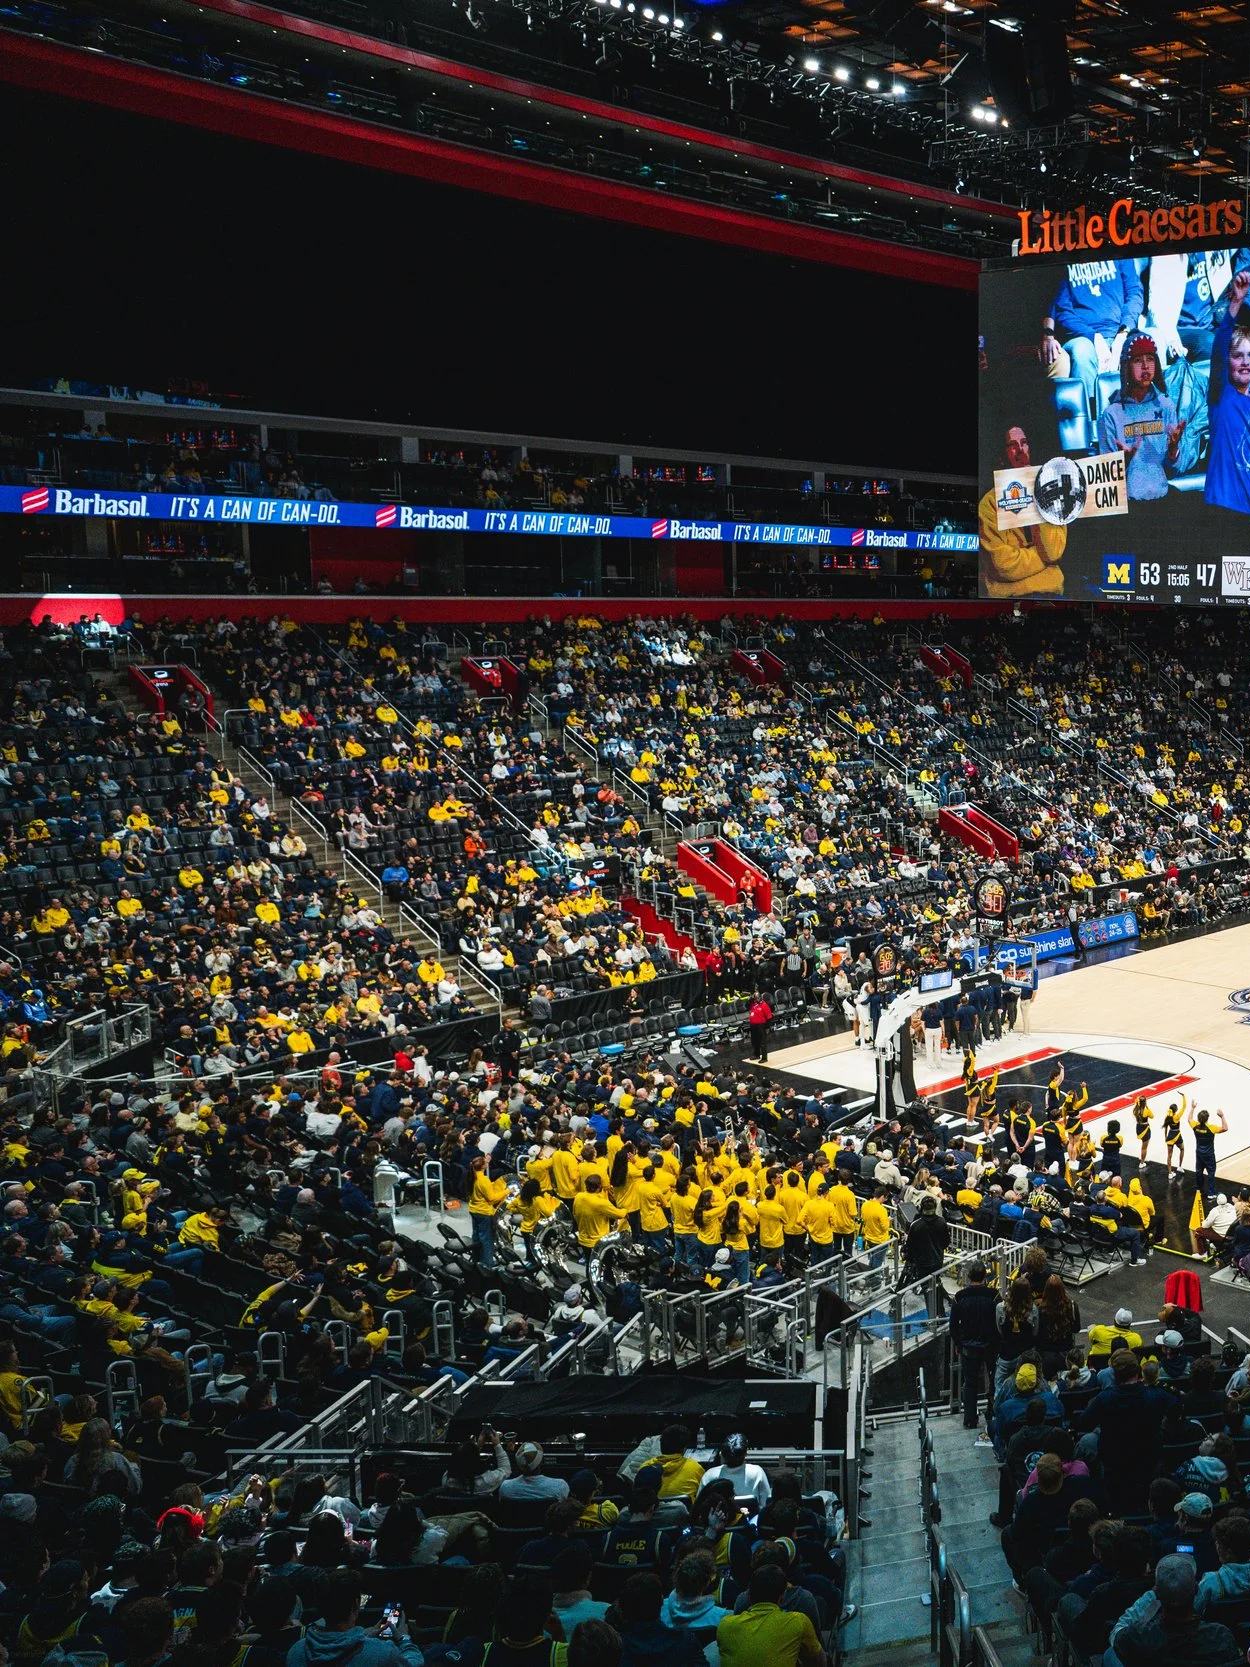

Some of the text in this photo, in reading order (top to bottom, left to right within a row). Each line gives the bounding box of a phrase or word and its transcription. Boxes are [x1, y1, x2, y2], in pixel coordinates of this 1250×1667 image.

[1018, 205, 1103, 255] Little
[1108, 199, 1243, 246] Caesars
[1087, 460, 1124, 485] DANCE
[55, 489, 341, 524] Barbasol IT'S A CAN OF CAN-DO.
[1095, 486, 1118, 508] CAM
[400, 506, 612, 535] Barbasol IT'S A CAN OF CAN-DO.
[670, 520, 832, 544] Barbasol IT'S A CAN OF CAN-DO.
[866, 529, 907, 547] Barbasol
[917, 533, 930, 547] IT'S
[932, 535, 937, 548] A
[939, 535, 954, 548] CAN
[956, 536, 966, 549] OF
[1107, 563, 1131, 583] M
[1140, 563, 1160, 585] 53
[1167, 573, 1190, 586] 15:05
[1196, 564, 1216, 586] 47
[984, 893, 1002, 912] 30
[879, 960, 891, 971] 30
[979, 948, 1018, 968] GCO
